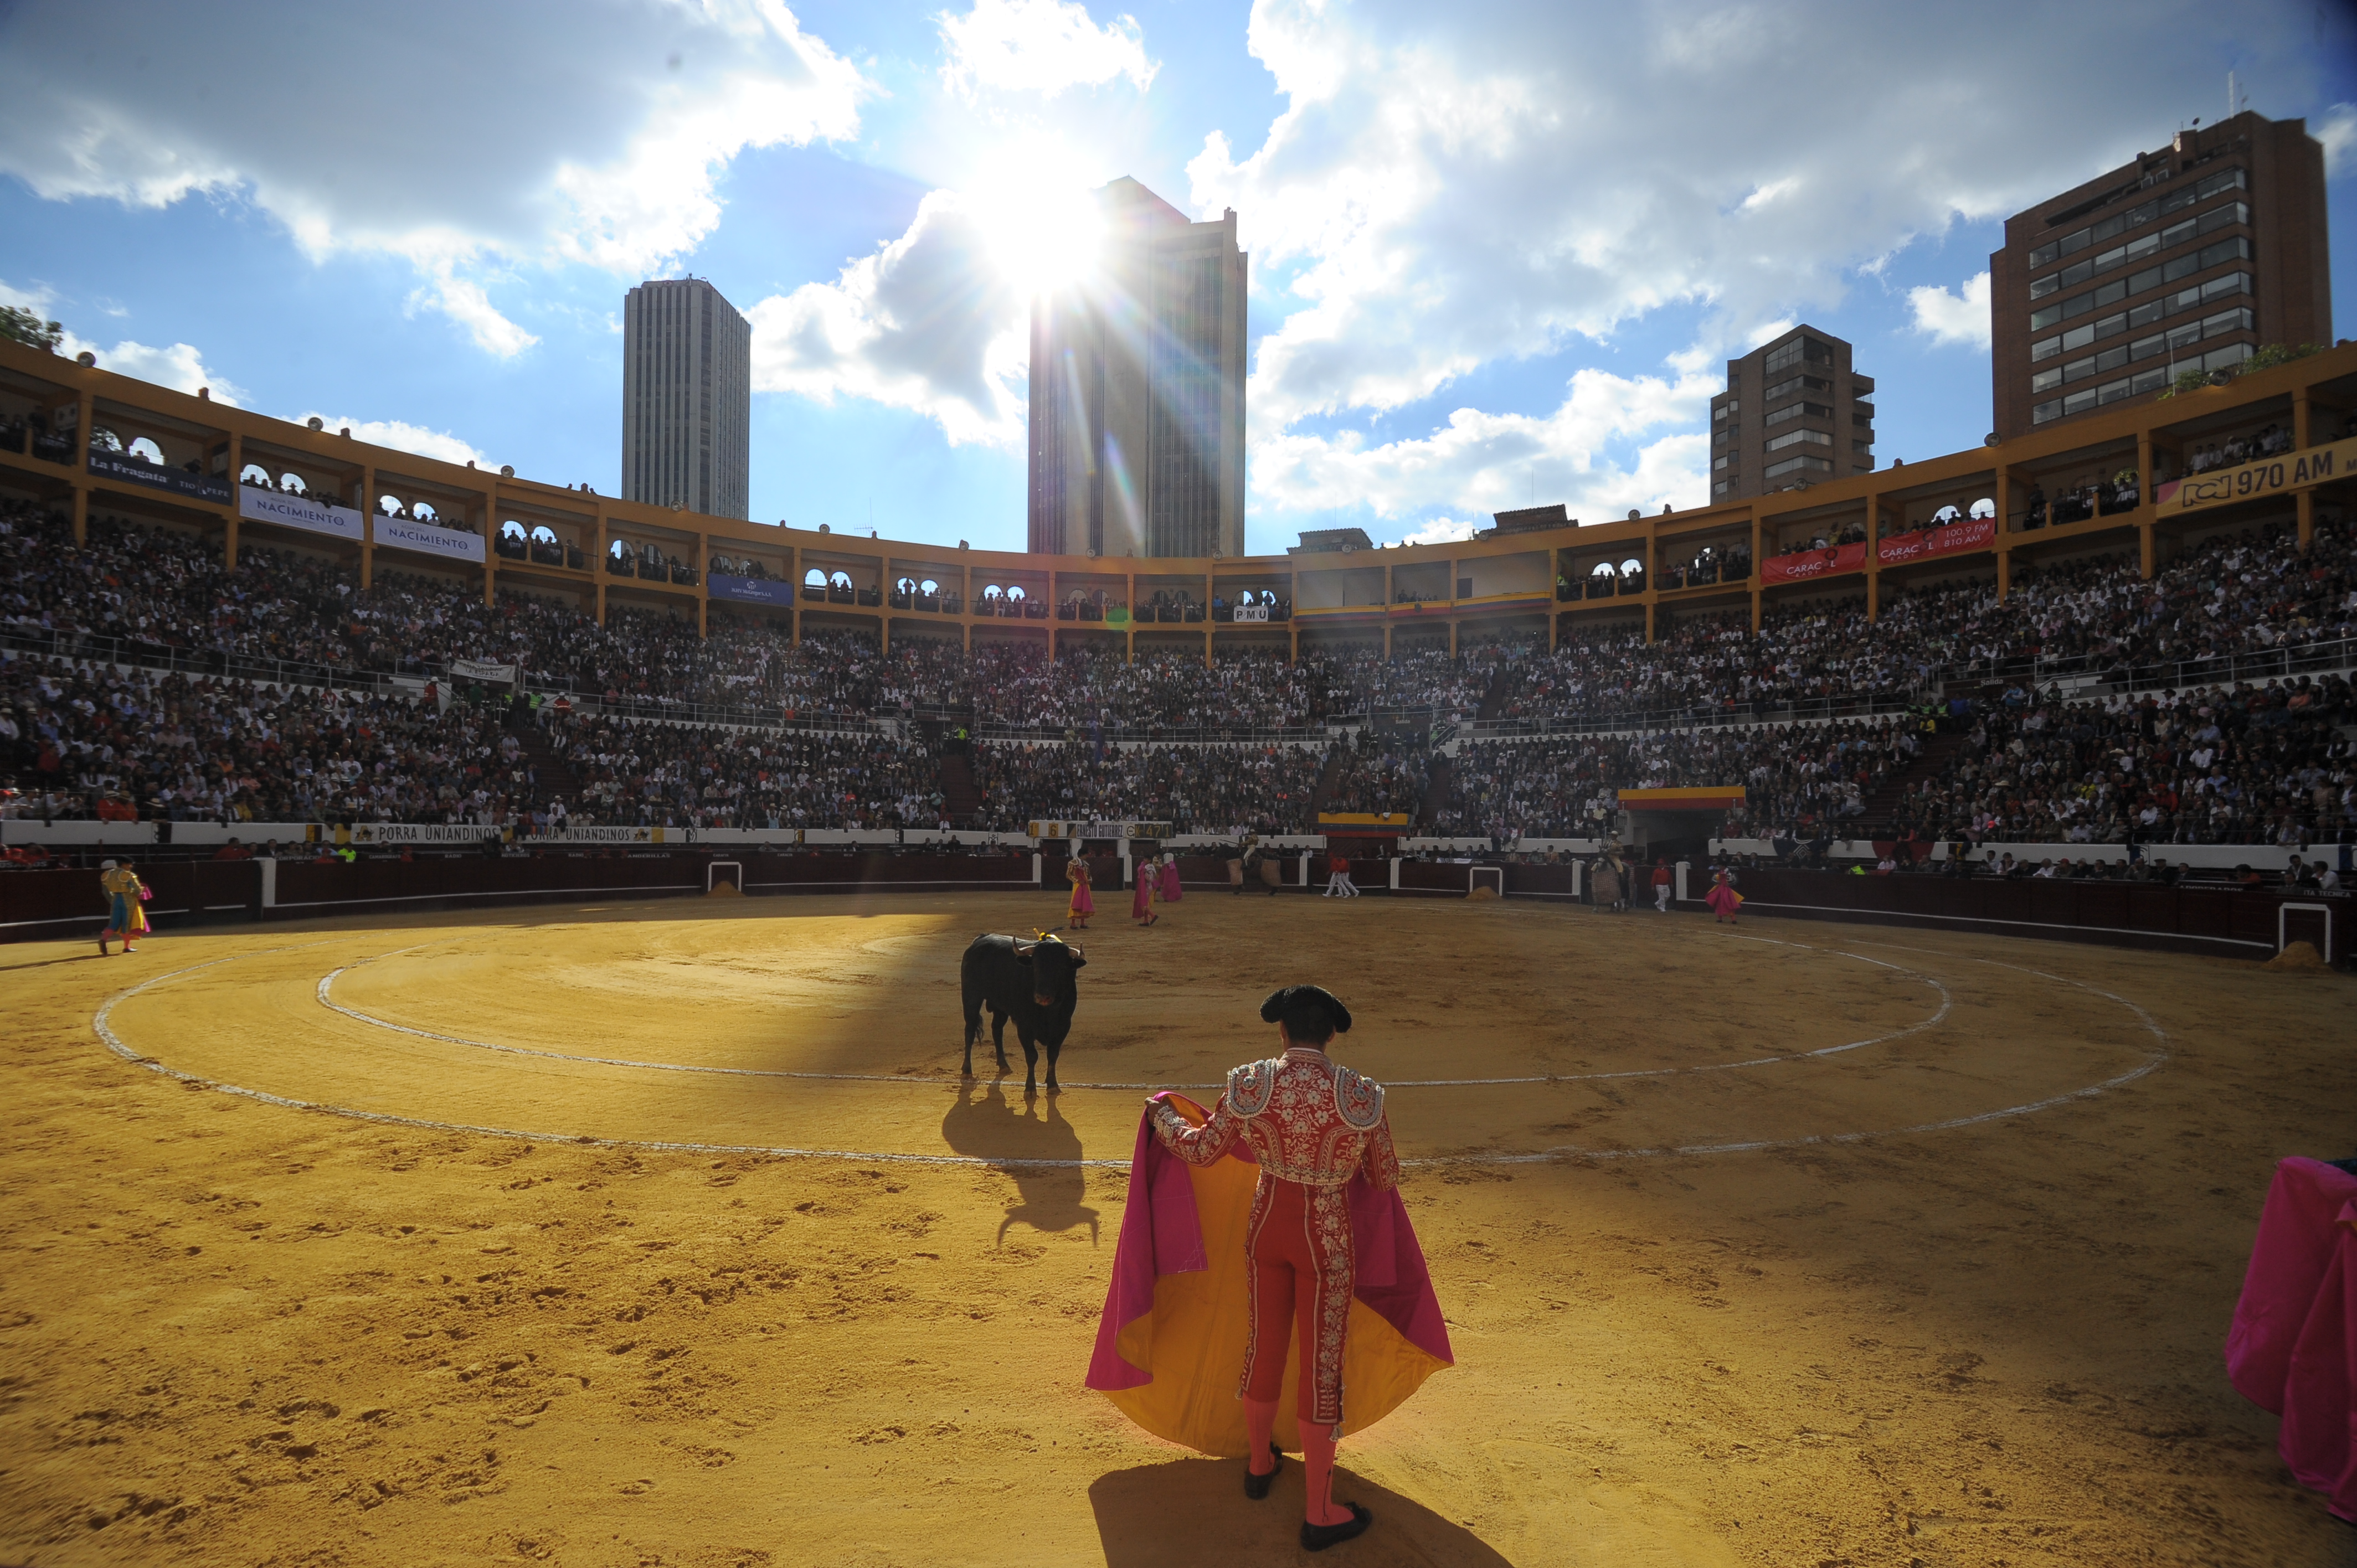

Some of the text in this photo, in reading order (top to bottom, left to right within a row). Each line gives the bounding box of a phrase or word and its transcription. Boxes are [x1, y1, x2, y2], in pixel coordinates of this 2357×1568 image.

[90, 456, 168, 484] La Fragata
[2237, 463, 2284, 496] 970
[2293, 450, 2333, 484] AM
[179, 480, 229, 497] TIO PEPE
[257, 500, 344, 526] NACIMIENTO
[1946, 523, 1988, 538] 100.9 FM
[389, 528, 468, 550] NACIMIENTO
[1944, 534, 1981, 548] 810 AM
[379, 827, 497, 840] PORRA UNIANDINOS
[566, 828, 630, 840] UNIANDINOS
[1098, 824, 1123, 838] GUTIERREZ
[2318, 888, 2351, 898] TECNICA
